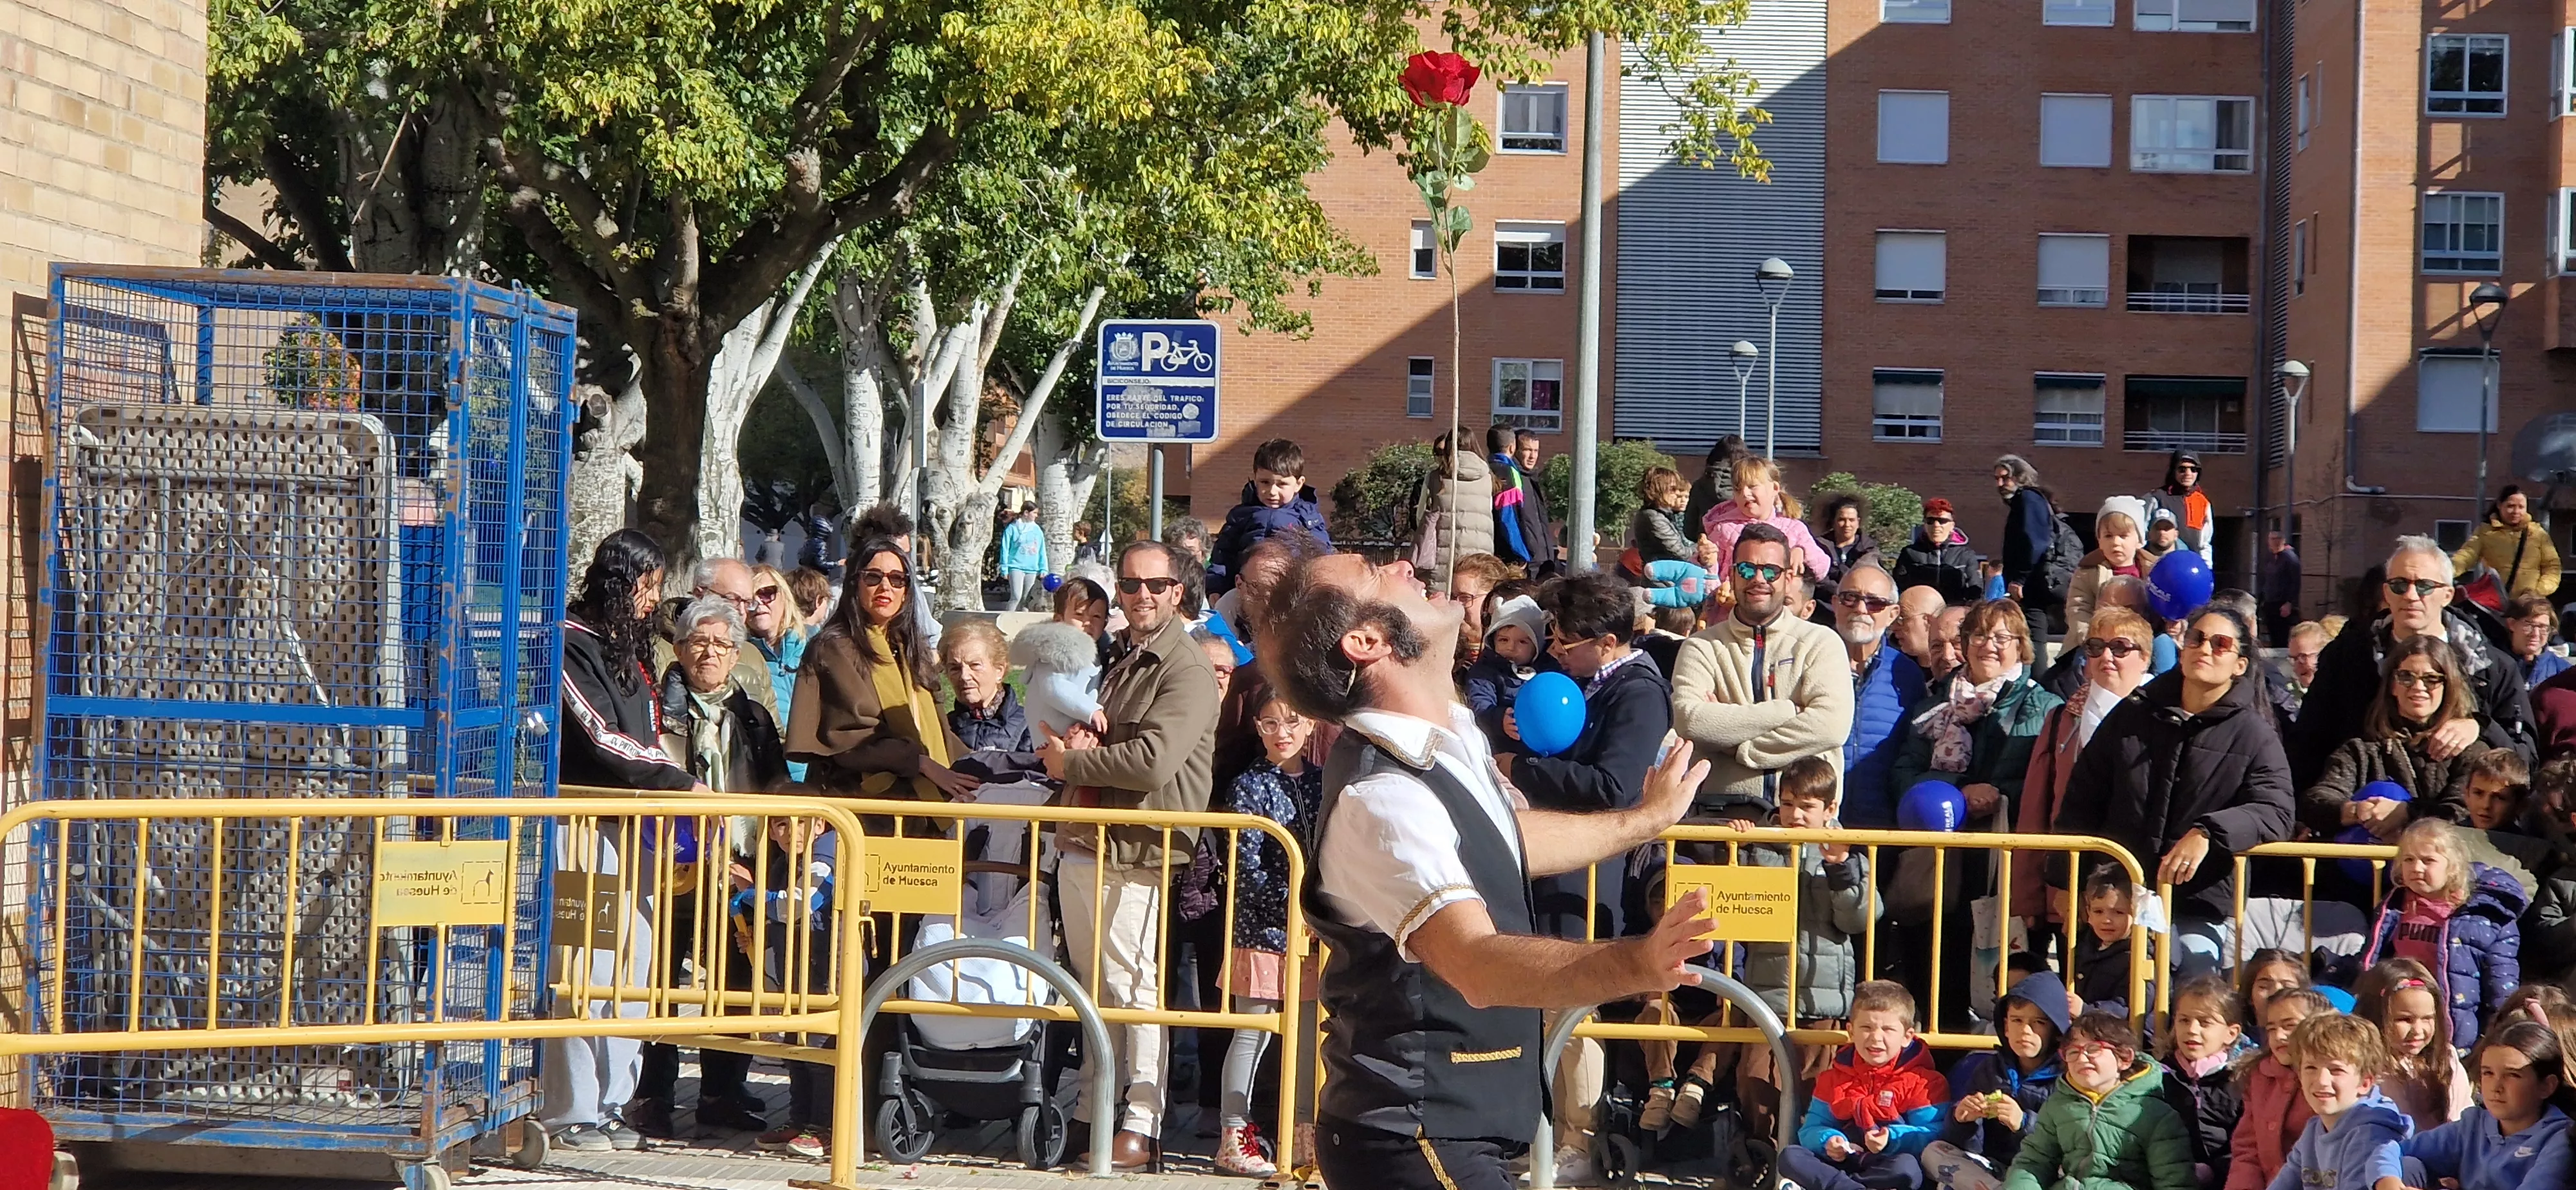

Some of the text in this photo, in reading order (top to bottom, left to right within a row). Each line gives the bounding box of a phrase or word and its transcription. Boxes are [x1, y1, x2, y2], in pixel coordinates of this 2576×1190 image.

[1141, 332, 1170, 372] P
[1127, 394, 1151, 402] PARTE
[883, 862, 955, 874] Ayuntamiento
[883, 876, 938, 887] de Huesca
[1716, 891, 1791, 903] Ayuntamiento
[1716, 904, 1773, 915] de Huesca
[2398, 922, 2439, 944] PUM
